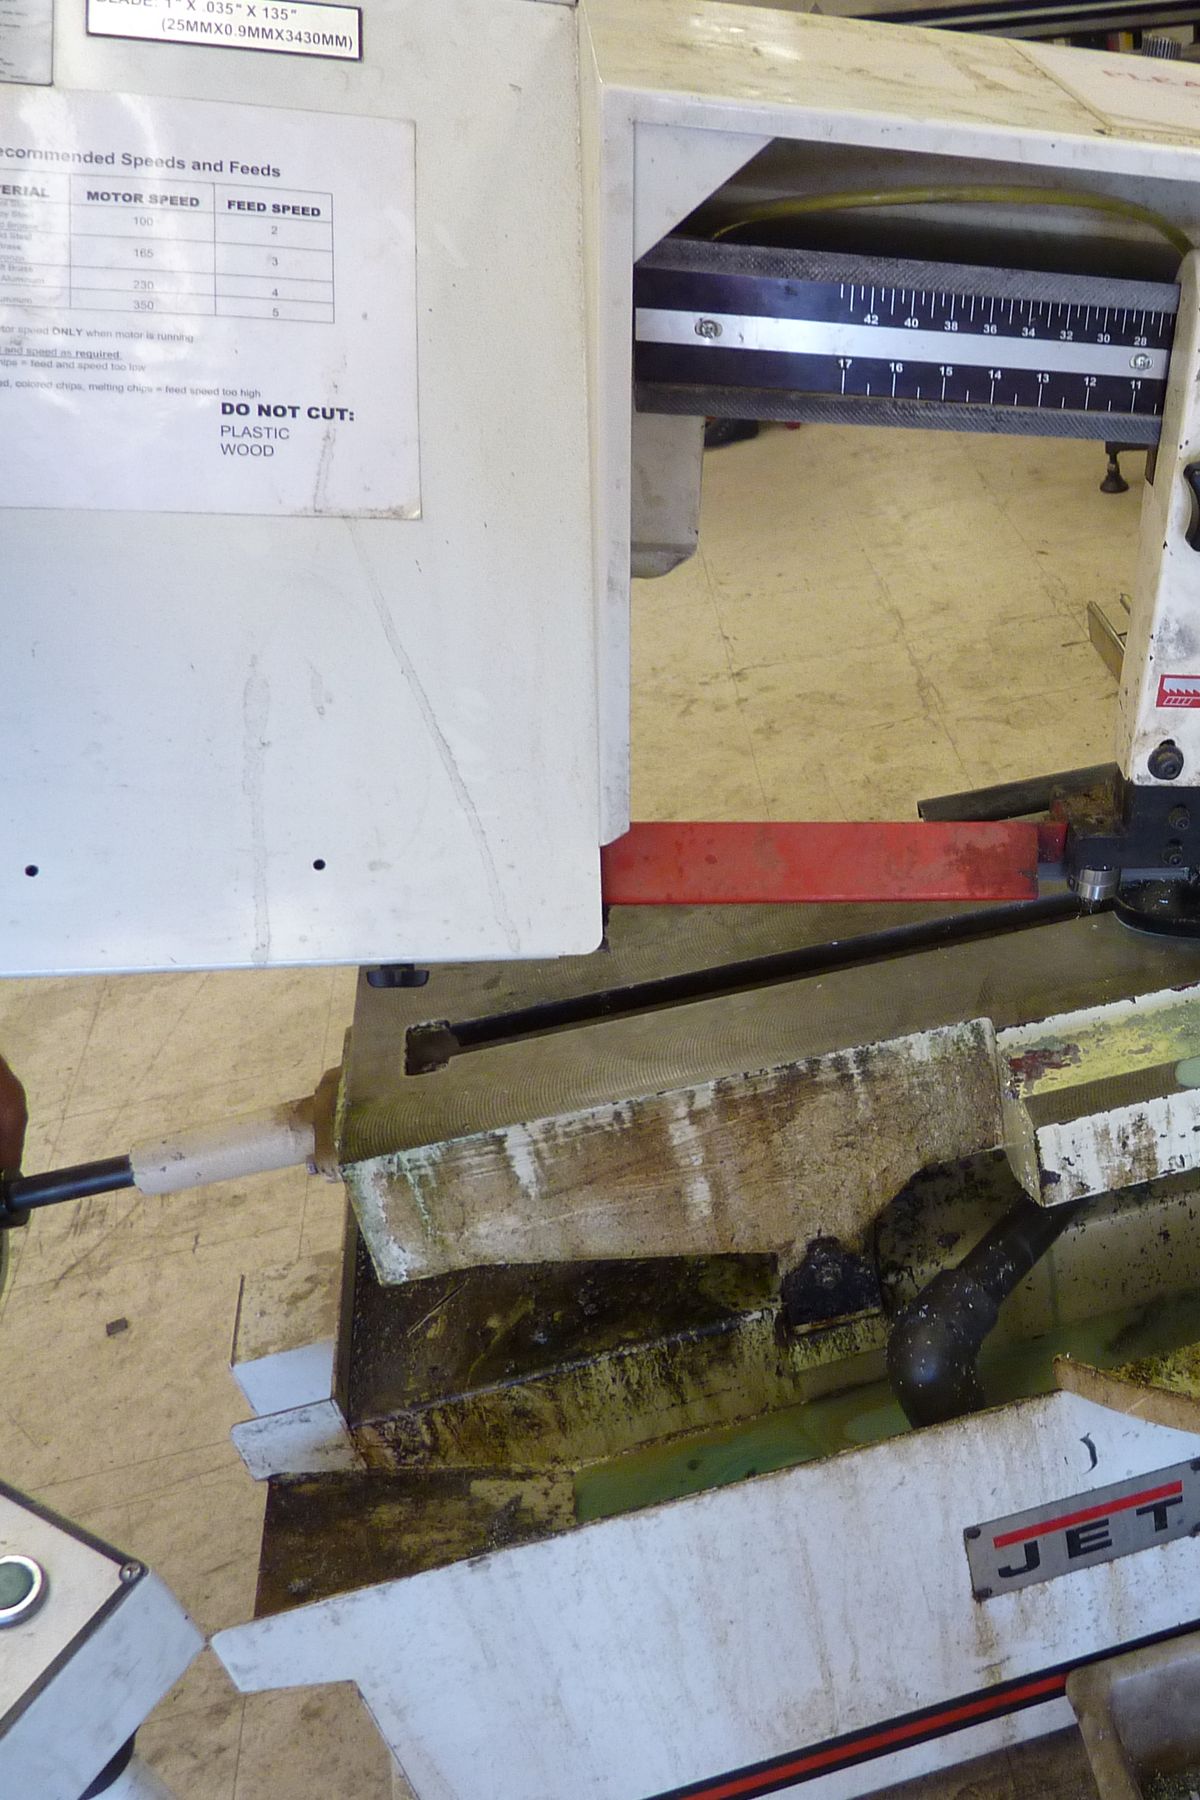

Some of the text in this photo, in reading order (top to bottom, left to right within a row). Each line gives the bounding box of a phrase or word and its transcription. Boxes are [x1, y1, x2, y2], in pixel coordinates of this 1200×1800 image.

[247, 6, 257, 18] X
[264, 7, 298, 21] 135"
[161, 18, 353, 50] (25MMX0.9MMX3430MM)
[121, 152, 186, 171] Speeds
[191, 159, 224, 173] and
[229, 160, 281, 178] Feeds
[0, 184, 50, 197] ERIAL
[87, 191, 200, 207] MOTOR SPEED
[227, 199, 321, 217] FEED SPEED
[133, 216, 154, 227] 100
[271, 226, 278, 235] 2
[133, 248, 154, 258] 165
[271, 257, 278, 266] 3
[271, 288, 278, 297] 4
[133, 300, 154, 311] 350
[272, 308, 279, 317] 5
[52, 327, 83, 337] ONLY
[86, 328, 112, 338] when
[115, 331, 143, 340] motor
[146, 331, 154, 340] is
[157, 332, 194, 344] running
[864, 314, 1148, 347] 42 40 38 36 34 32 30 28
[56, 360, 75, 370] and
[78, 361, 107, 372] speed
[838, 358, 1142, 391] 17 16 15 14 13 12 11
[88, 382, 125, 395] melting
[165, 385, 187, 394] feed
[222, 387, 237, 397] too
[240, 387, 261, 399] high
[221, 402, 355, 421] DO NOT CUT:
[220, 424, 290, 440] PLASTIC
[220, 443, 275, 457] WOOD
[997, 1495, 1183, 1578] JET
